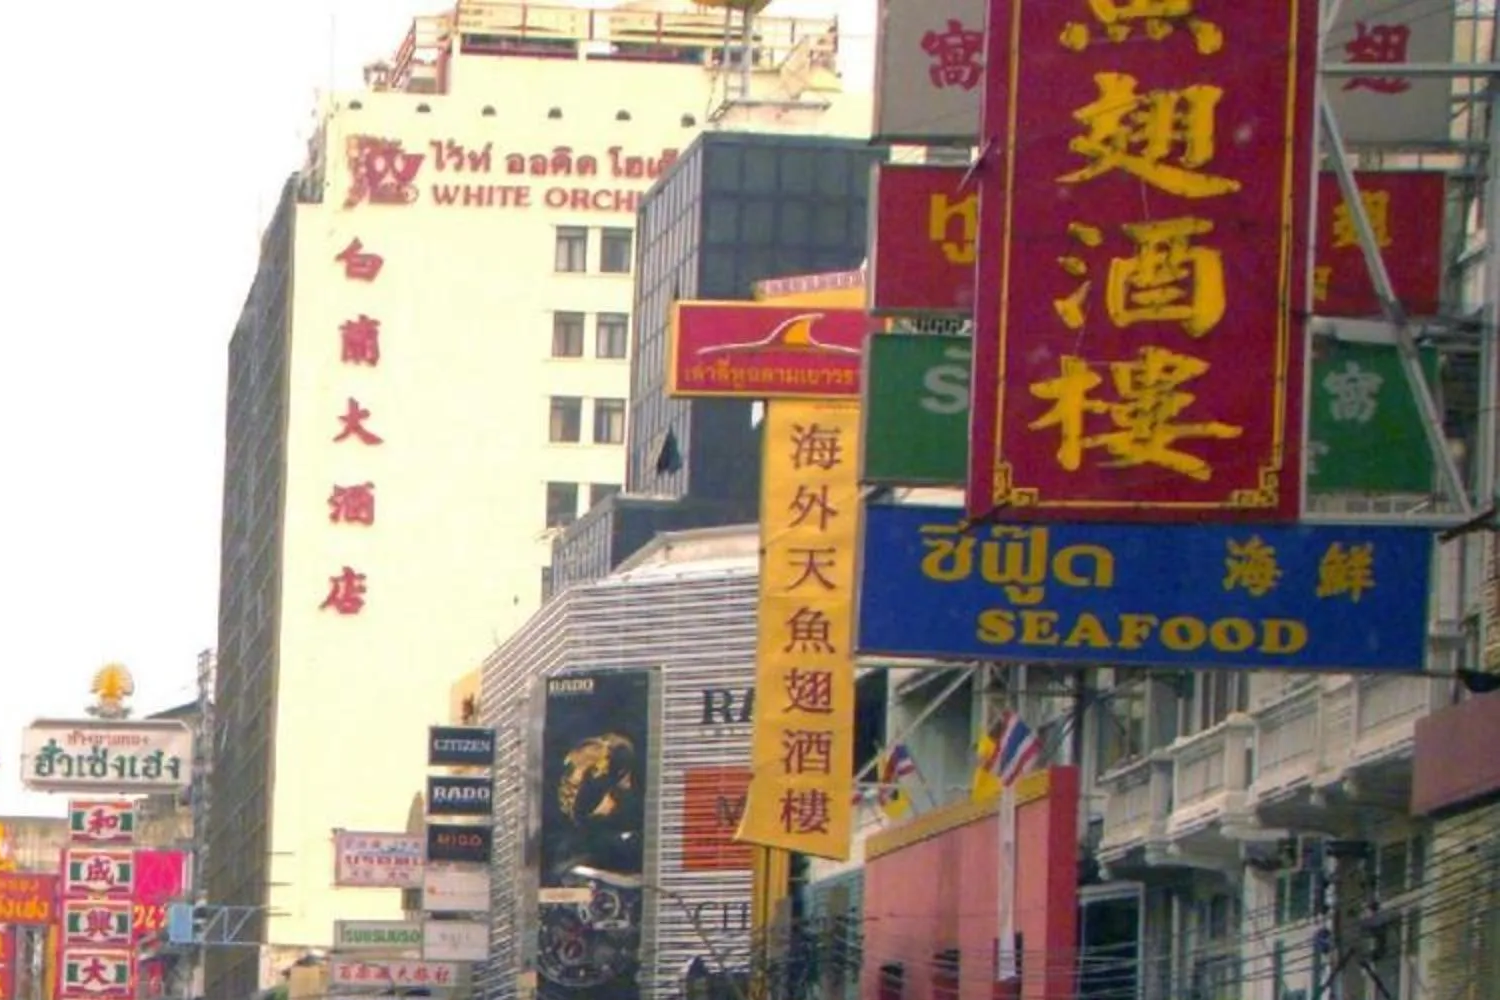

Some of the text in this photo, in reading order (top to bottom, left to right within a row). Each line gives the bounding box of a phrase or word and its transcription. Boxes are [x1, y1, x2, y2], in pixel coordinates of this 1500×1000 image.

[431, 185, 531, 208] WHITE
[1222, 536, 1376, 604] 海鮮
[778, 421, 843, 836] 海外天魚翅酒樓
[976, 609, 1309, 654] SEAFOOD
[433, 738, 491, 753] CITIZEN
[433, 785, 491, 801] RADO
